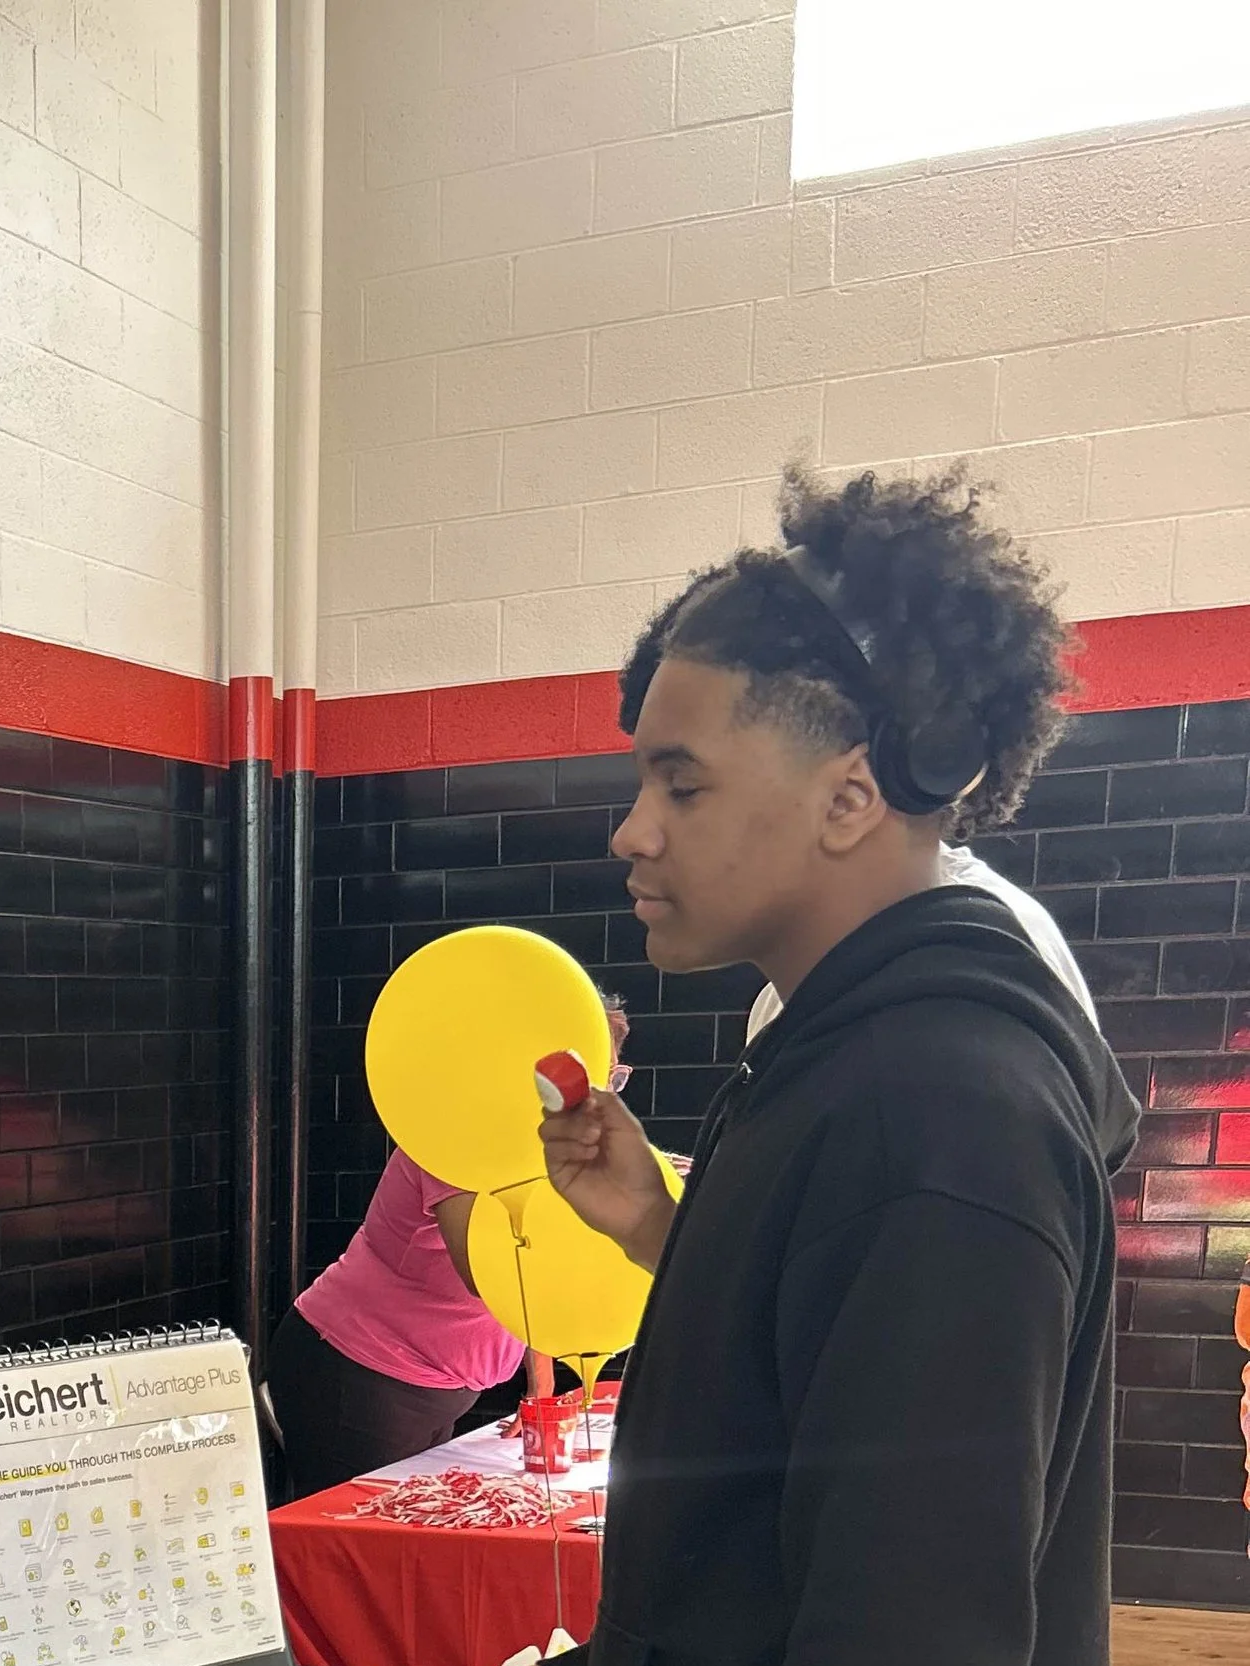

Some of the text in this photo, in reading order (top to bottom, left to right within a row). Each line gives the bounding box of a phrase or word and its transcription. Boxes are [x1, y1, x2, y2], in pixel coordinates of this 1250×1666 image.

[126, 1368, 241, 1401] Advantage Plus
[11, 1465, 43, 1480] GUIDE
[45, 1461, 67, 1475] YOU
[69, 1452, 118, 1470] THROUGH
[120, 1449, 141, 1462] THIS
[144, 1441, 190, 1458] COMPLEX
[192, 1433, 236, 1450] PROCESS
[20, 1489, 33, 1498] Way
[35, 1486, 54, 1496] paves
[55, 1484, 65, 1492] the
[66, 1481, 81, 1491] path
